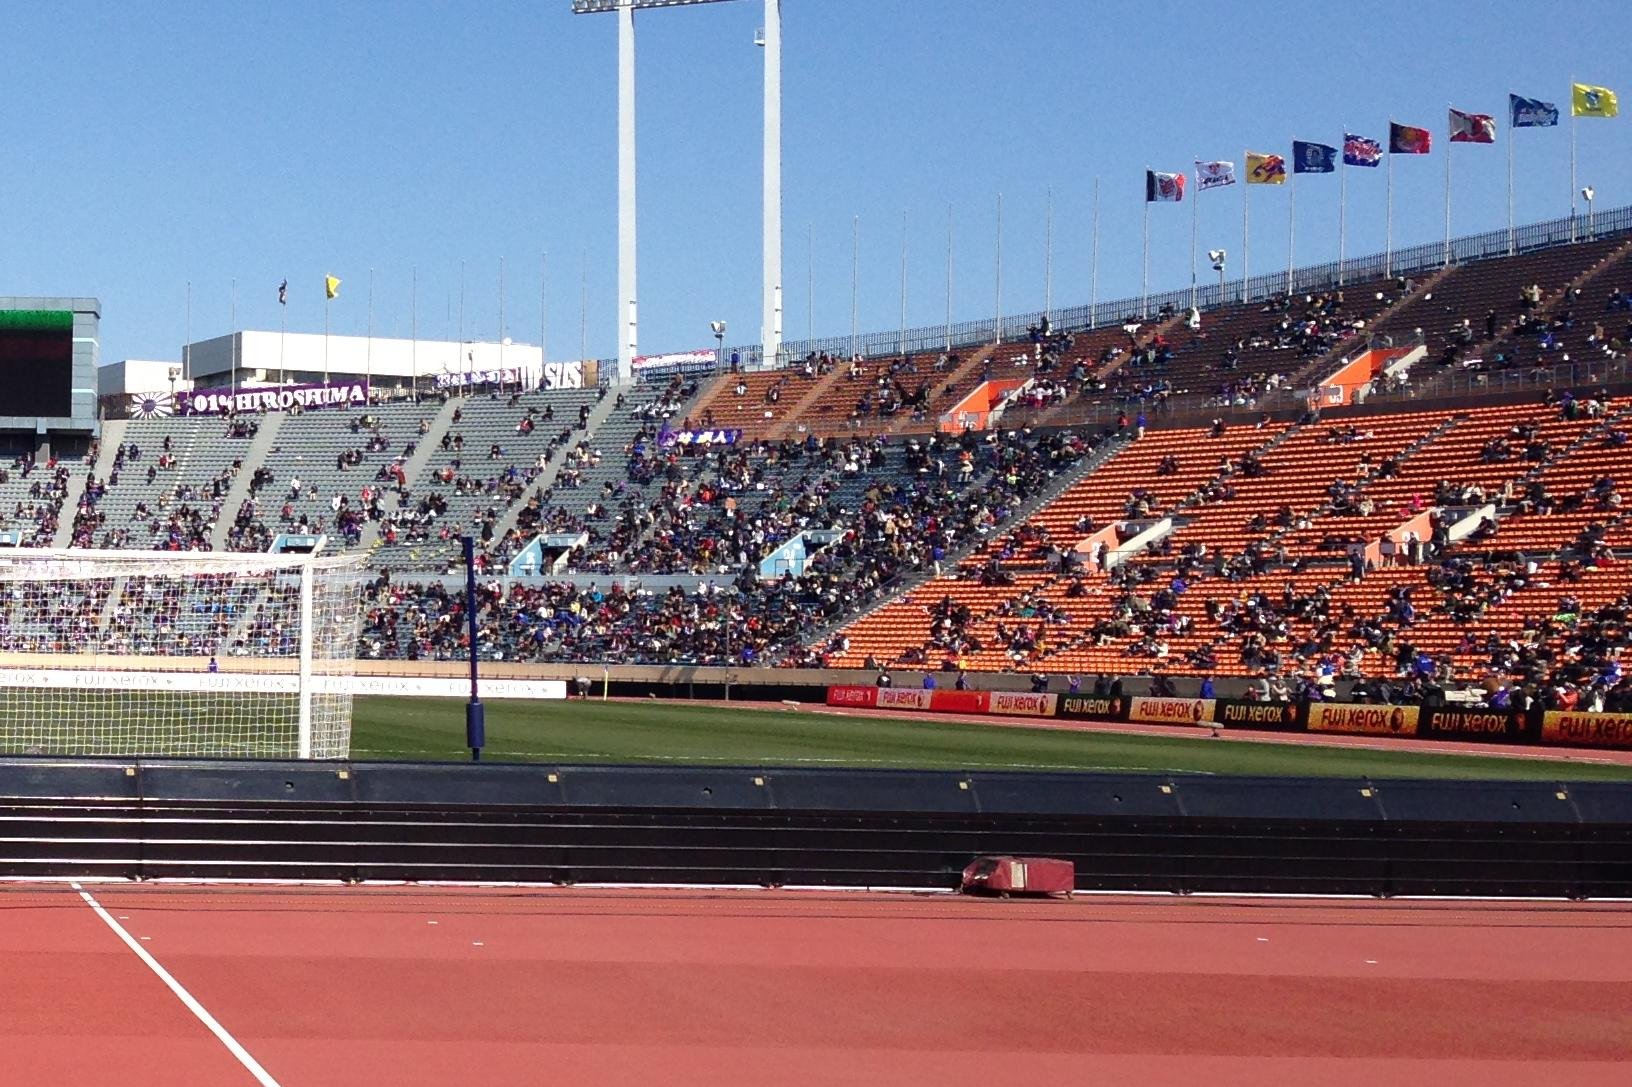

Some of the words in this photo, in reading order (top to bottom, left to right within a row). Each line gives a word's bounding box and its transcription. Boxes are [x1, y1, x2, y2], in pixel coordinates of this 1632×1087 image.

[997, 695, 1015, 710] FUJI
[1017, 697, 1038, 711] xerox
[1064, 698, 1081, 712] FUJI
[1083, 699, 1110, 714] xerox
[1139, 702, 1159, 717] FUJI
[1160, 702, 1191, 718] xerox
[1224, 704, 1246, 721] FUJI
[1247, 706, 1284, 723] xerox
[1321, 707, 1345, 726] FUJI
[1347, 708, 1388, 728] xerox
[1431, 712, 1460, 731] FUJI
[1463, 713, 1508, 733] xerox
[1558, 716, 1590, 740] FUJI
